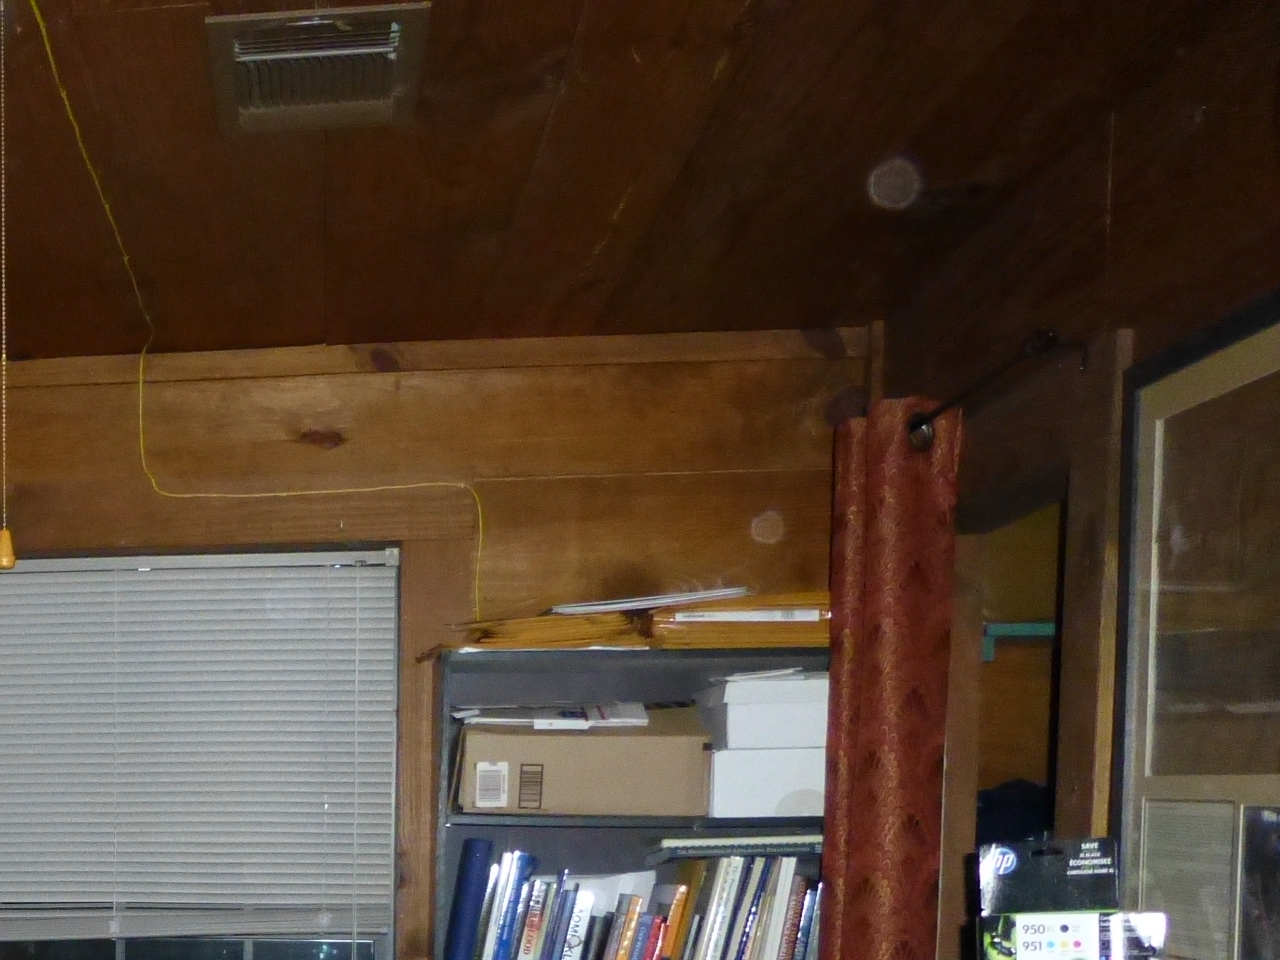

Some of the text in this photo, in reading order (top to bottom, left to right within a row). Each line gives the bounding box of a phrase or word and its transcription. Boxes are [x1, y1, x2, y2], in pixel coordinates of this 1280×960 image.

[994, 852, 1013, 874] hp
[1022, 923, 1045, 934] 950
[1022, 941, 1042, 951] 951
